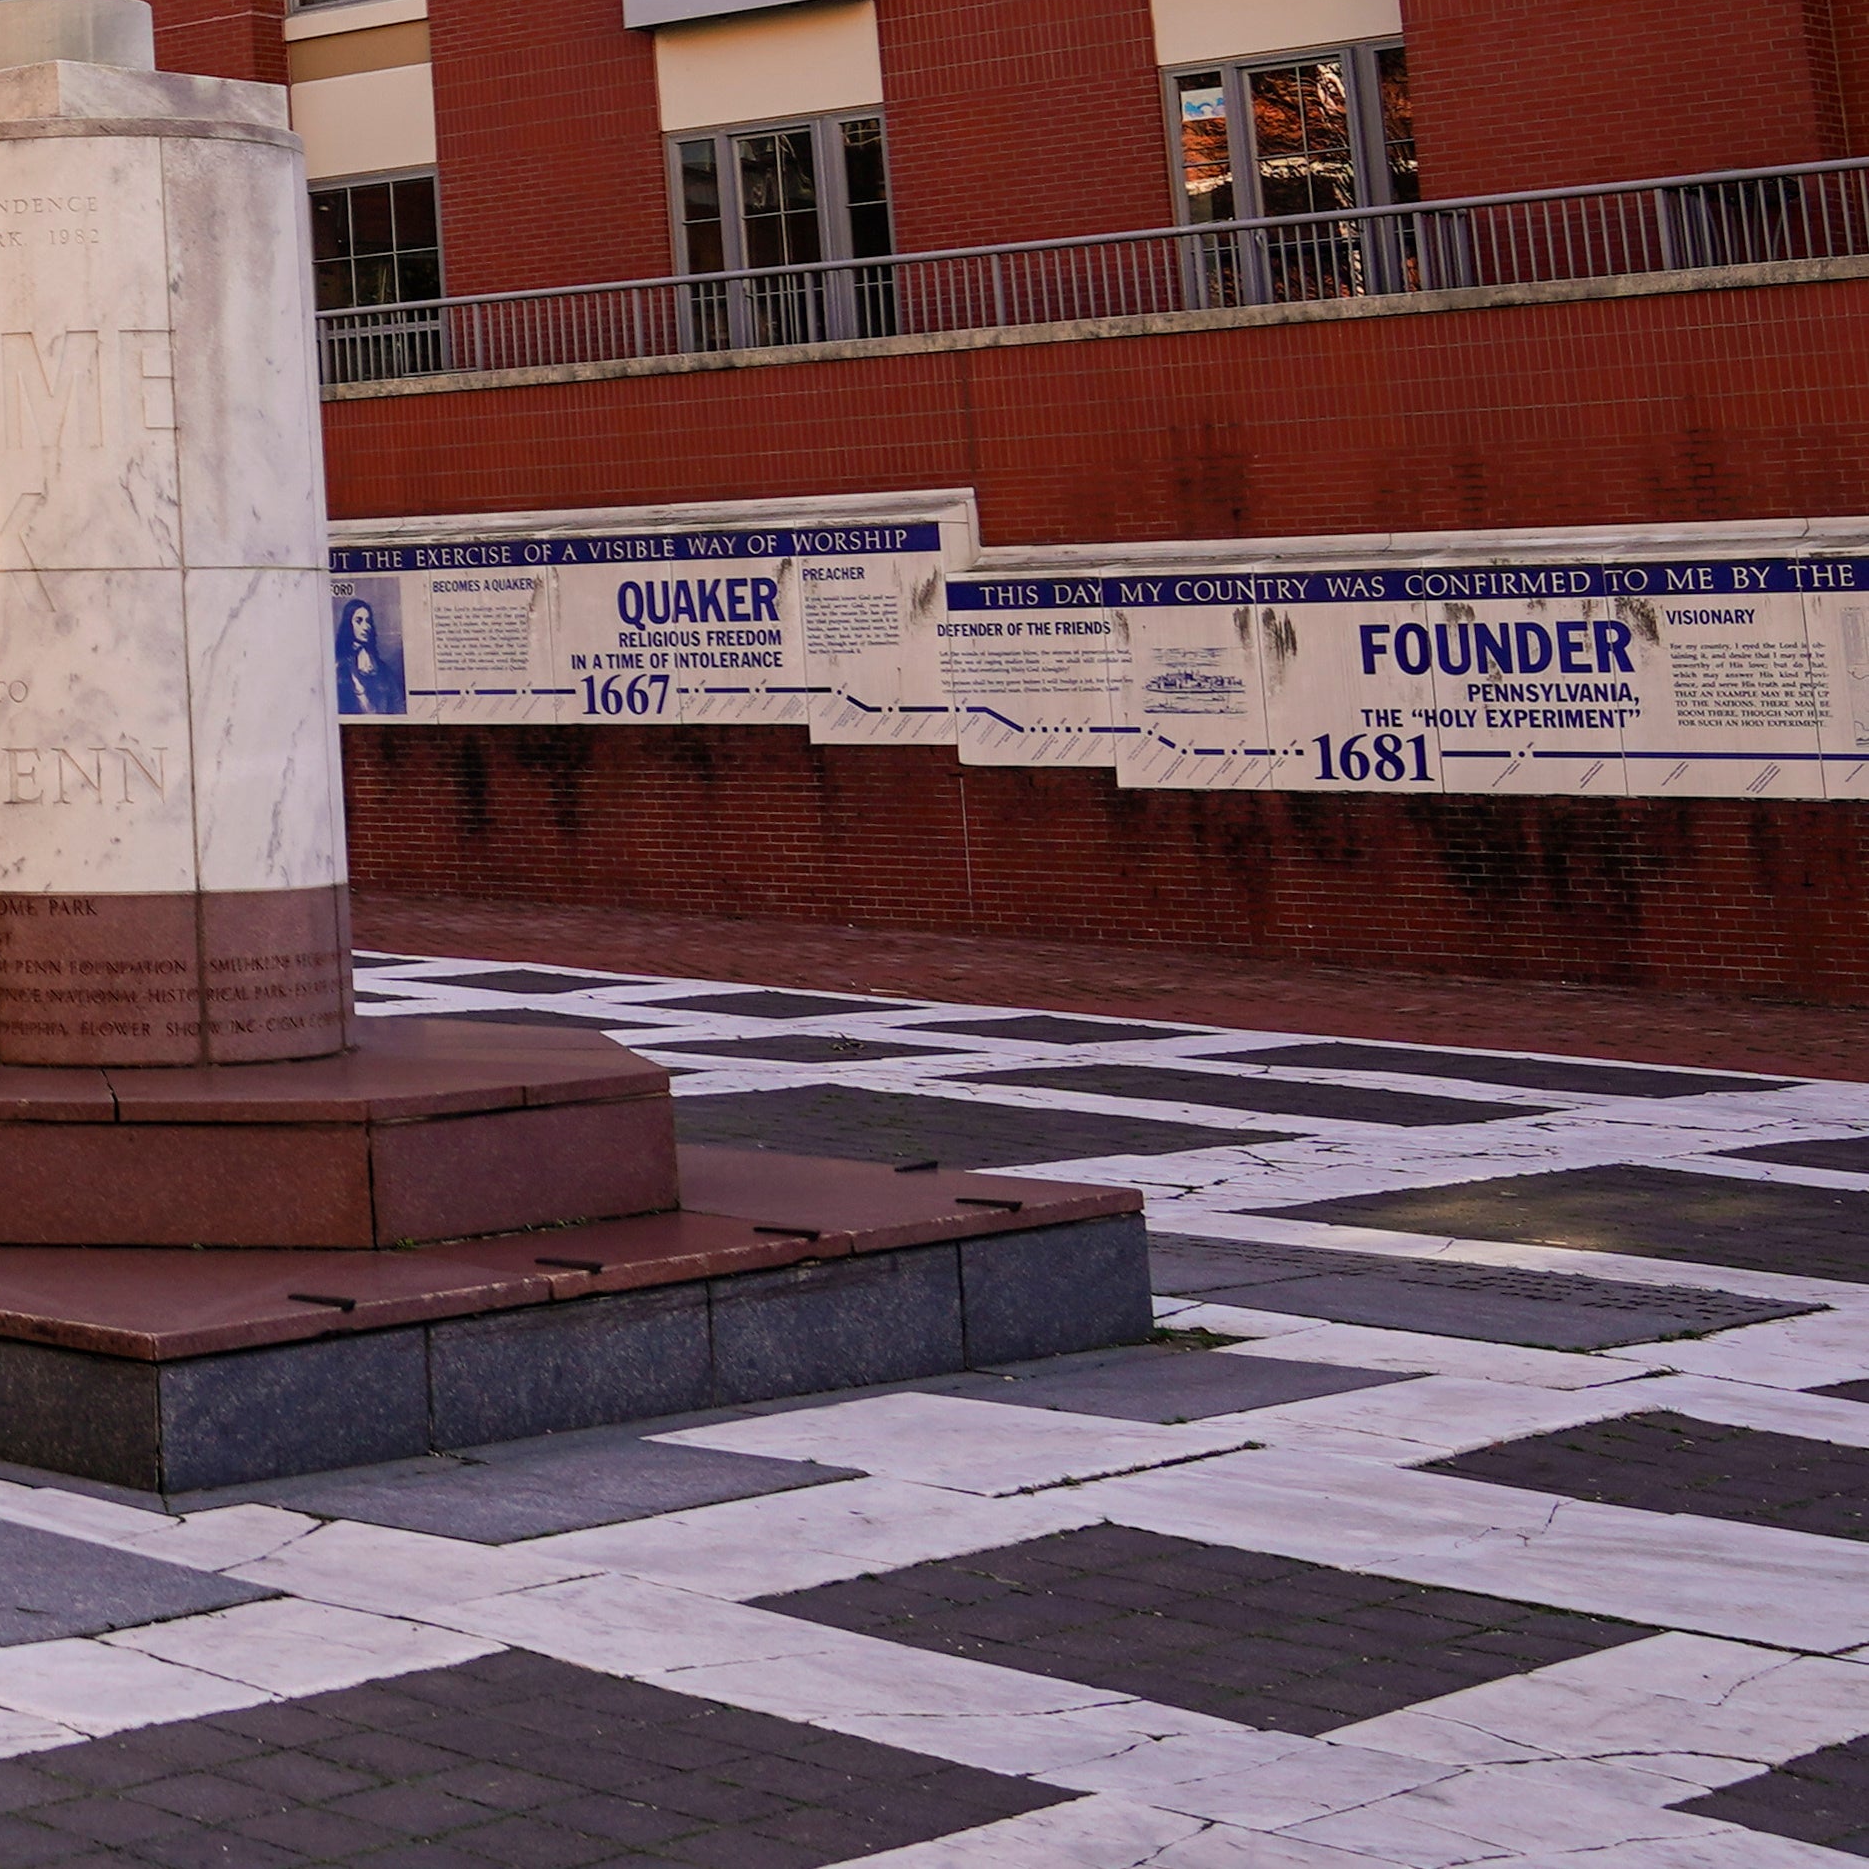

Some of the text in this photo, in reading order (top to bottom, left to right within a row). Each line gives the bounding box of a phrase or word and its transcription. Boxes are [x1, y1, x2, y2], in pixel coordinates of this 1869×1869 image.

[48, 229, 100, 245] 1982
[362, 551, 402, 569] THE
[416, 545, 512, 567] EXERCISE
[524, 543, 552, 563] OF
[562, 543, 583, 561] A
[587, 537, 675, 560] VISIBLE
[688, 536, 738, 556] WAY
[747, 534, 778, 555] OF
[791, 529, 908, 553] WORSHIP
[802, 567, 865, 581] PREACHER
[433, 580, 481, 593] BECOMES
[492, 577, 534, 592] QUAKER
[980, 563, 1856, 607] THIS DAY MY COUNTRY WAS CONFIRMED TO ME BY THE
[617, 577, 780, 631] QUAKER
[1666, 609, 1755, 625] VISIONARY
[937, 620, 1111, 637] DEFENDER OF THE FRIENDS
[619, 629, 782, 648] RELIGIOUS FREEDOM
[1359, 619, 1635, 676] FOUNDER
[572, 650, 783, 670] IN A TIME OF INTOLERANCE
[581, 674, 671, 716] 1667
[1467, 682, 1640, 706] PENNSYLVANIA,
[1361, 708, 1403, 728] THE
[1312, 733, 1436, 782] 1681
[50, 899, 98, 917] PARK
[15, 960, 64, 975] PENN
[70, 959, 187, 975] FOUNDATION
[80, 1020, 151, 1037] FLOWER
